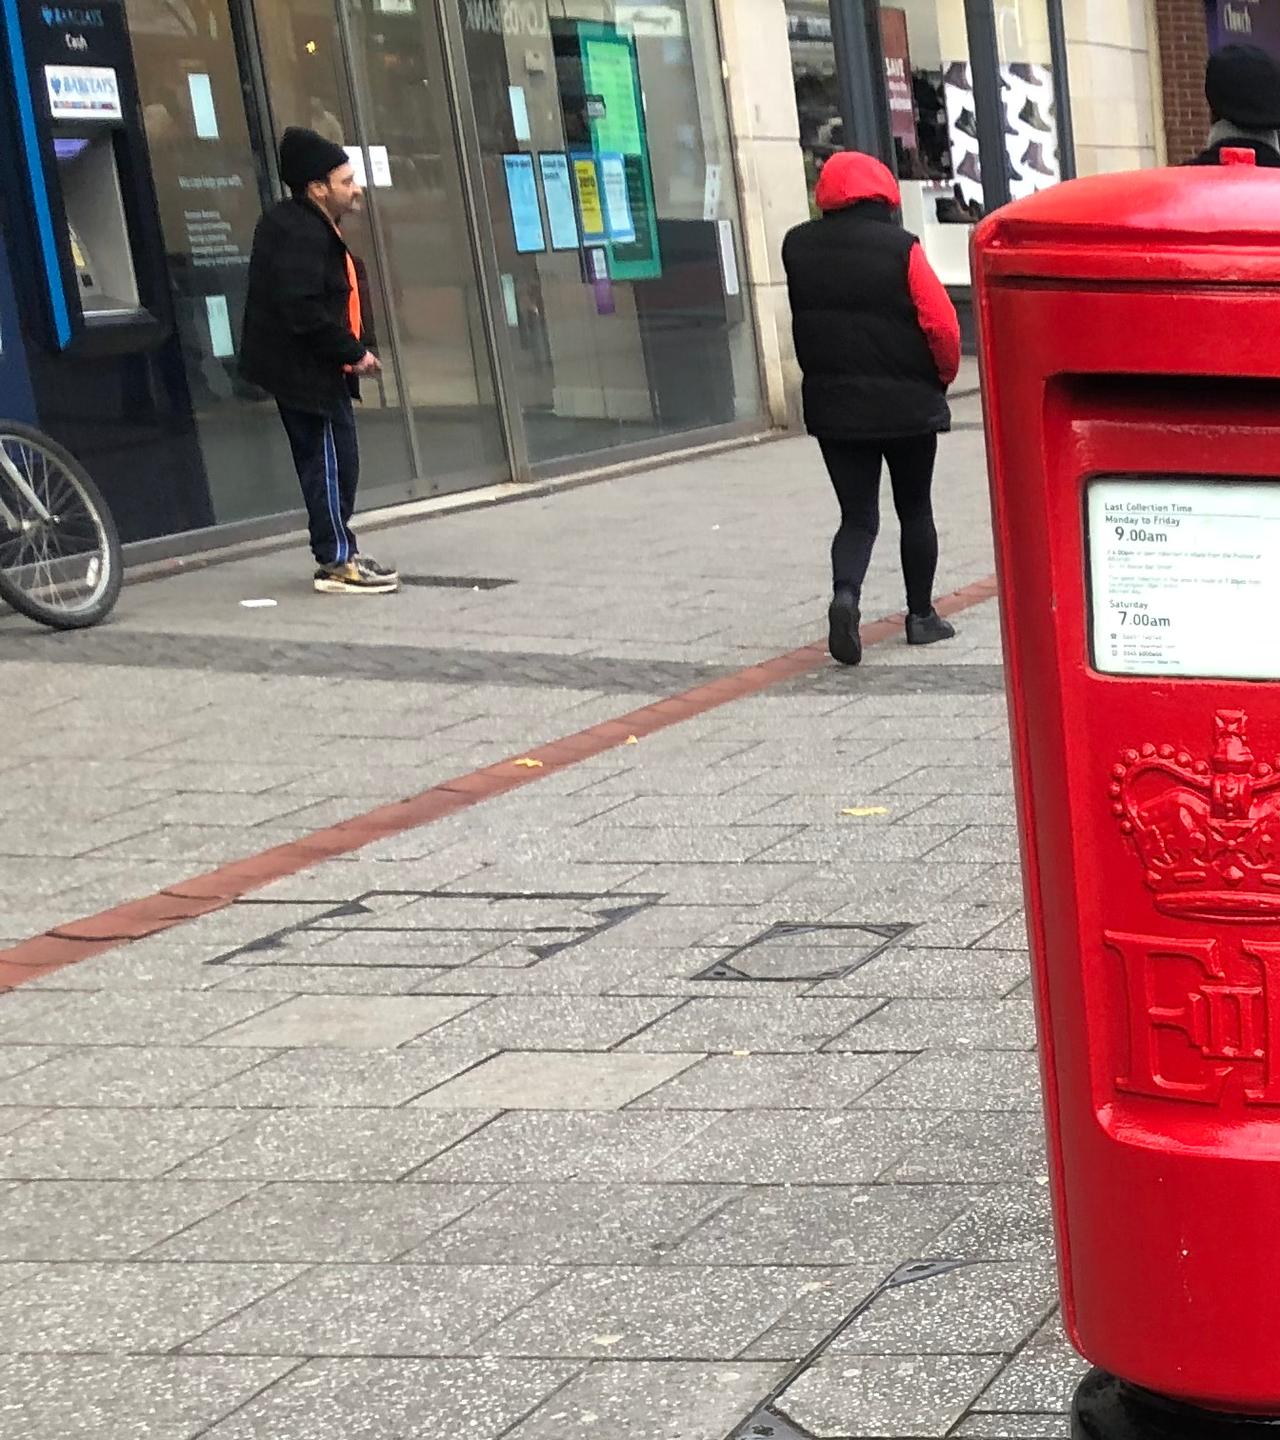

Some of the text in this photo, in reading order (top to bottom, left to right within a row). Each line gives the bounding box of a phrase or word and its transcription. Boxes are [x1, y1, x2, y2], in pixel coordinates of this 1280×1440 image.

[1224, 4, 1251, 33] Church
[65, 32, 88, 51] Cash
[1104, 502, 1193, 512] Last Collection Time
[1105, 515, 1180, 527] Monday to Friday
[1114, 526, 1168, 543] 9.00am
[1109, 599, 1149, 609] Saturday
[1118, 610, 1171, 628] 7.00am
